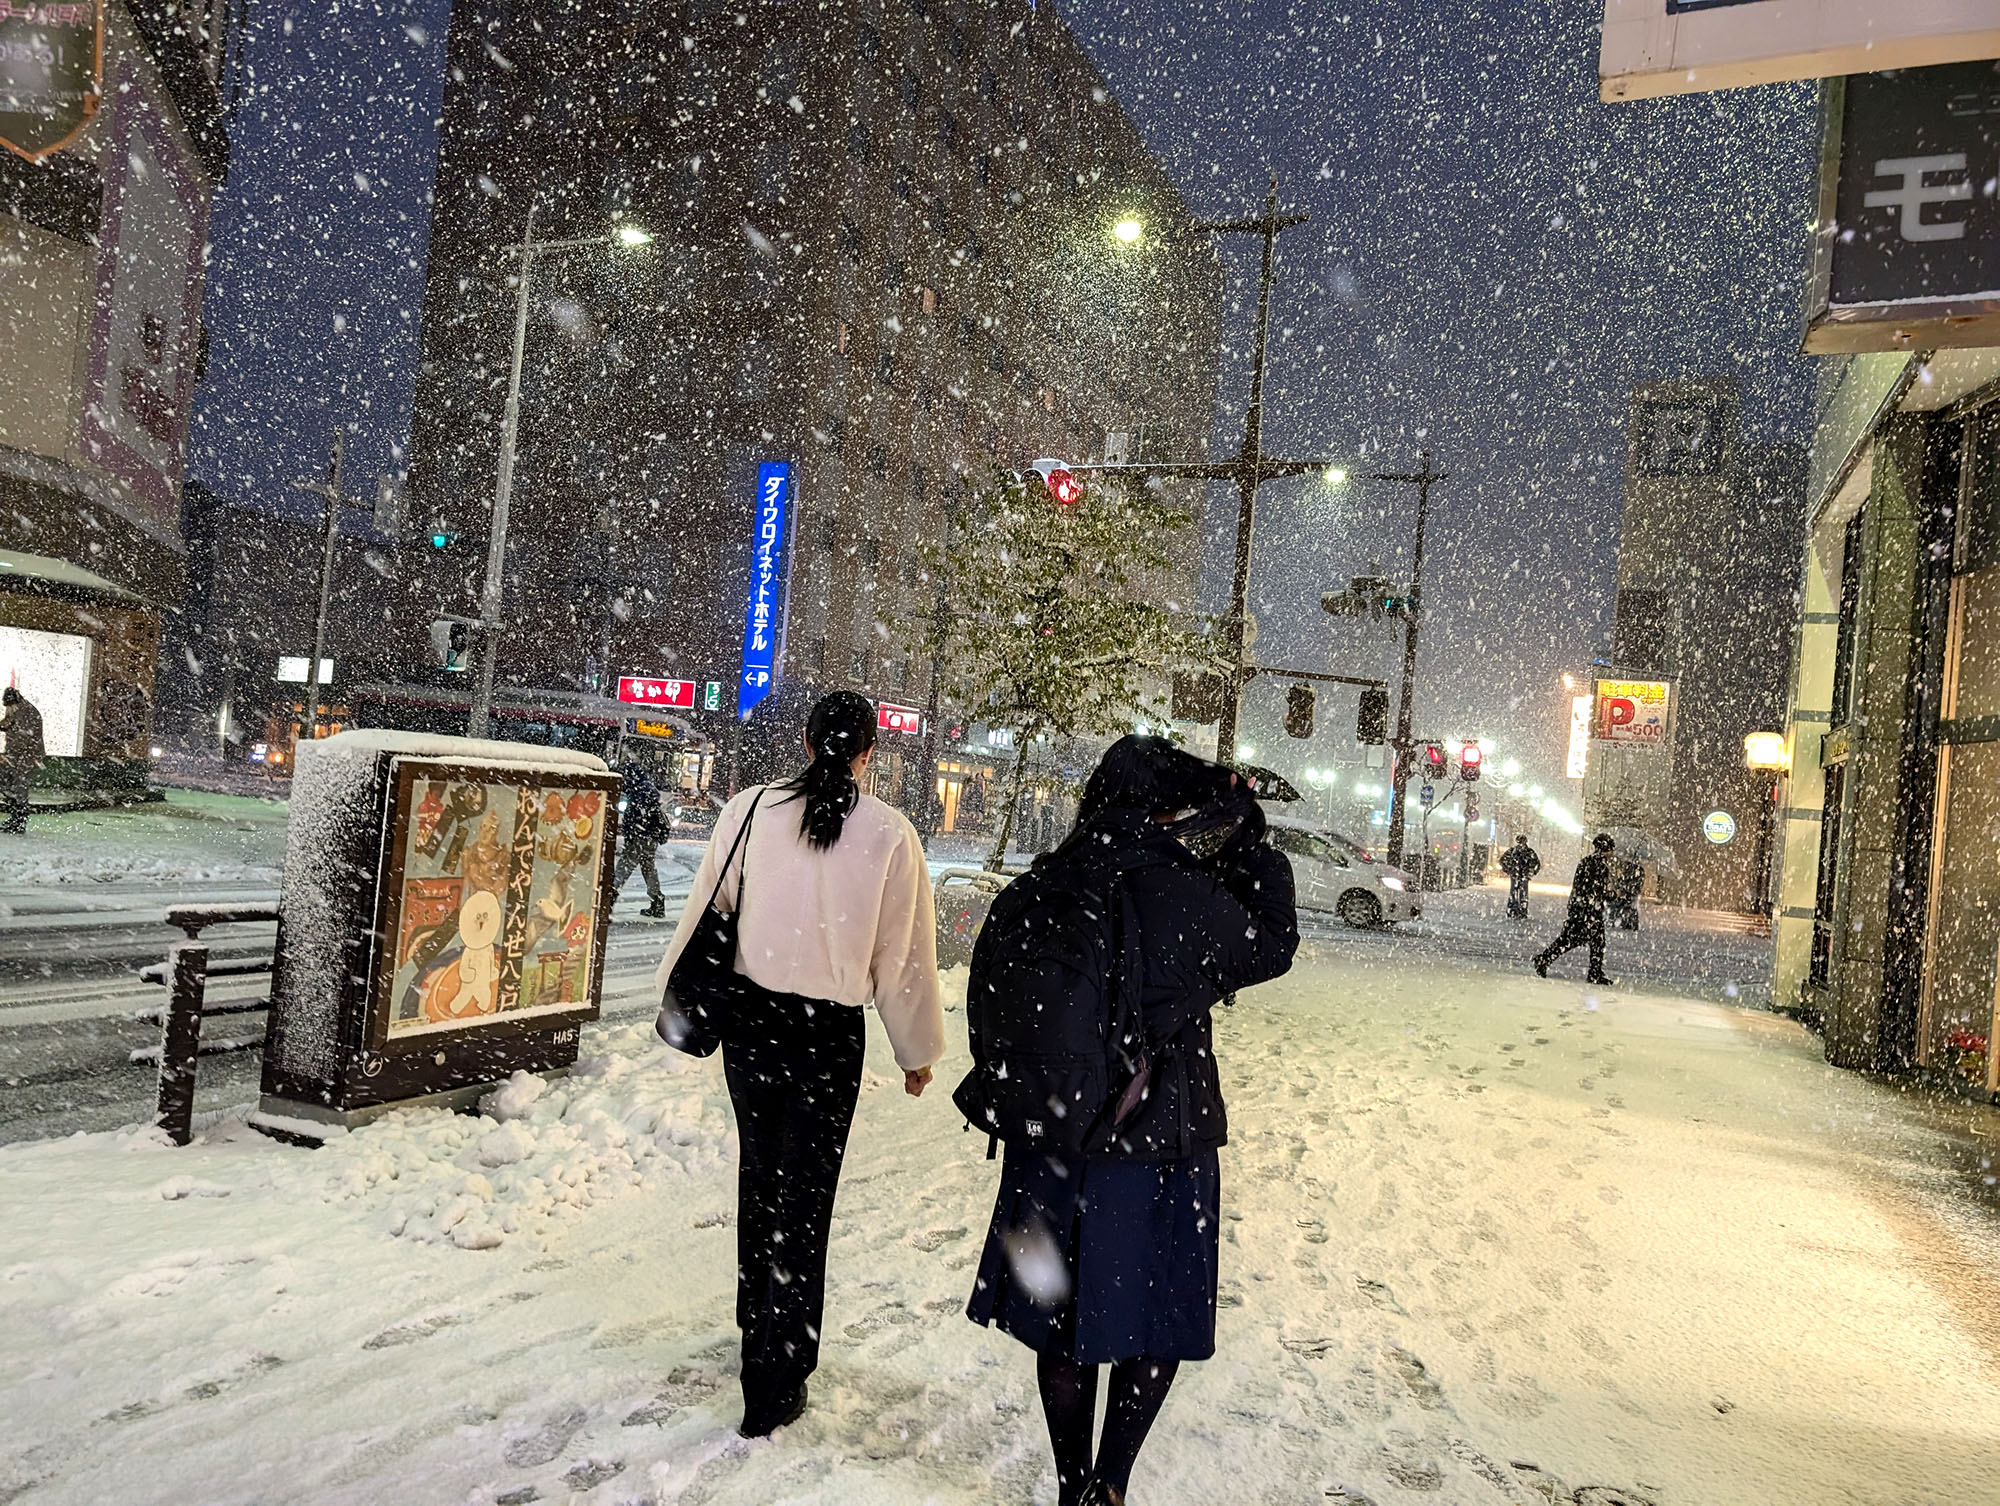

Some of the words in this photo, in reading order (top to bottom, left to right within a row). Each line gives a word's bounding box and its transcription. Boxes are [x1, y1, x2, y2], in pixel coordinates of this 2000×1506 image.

[1863, 153, 2000, 242] モ
[751, 476, 785, 651] ダイワロイネットホテル
[631, 679, 681, 704] なか卯
[757, 671, 769, 688] P
[1600, 697, 1635, 740] P
[1633, 723, 1664, 737] 500
[497, 787, 537, 1013] おんでやんせ八戸
